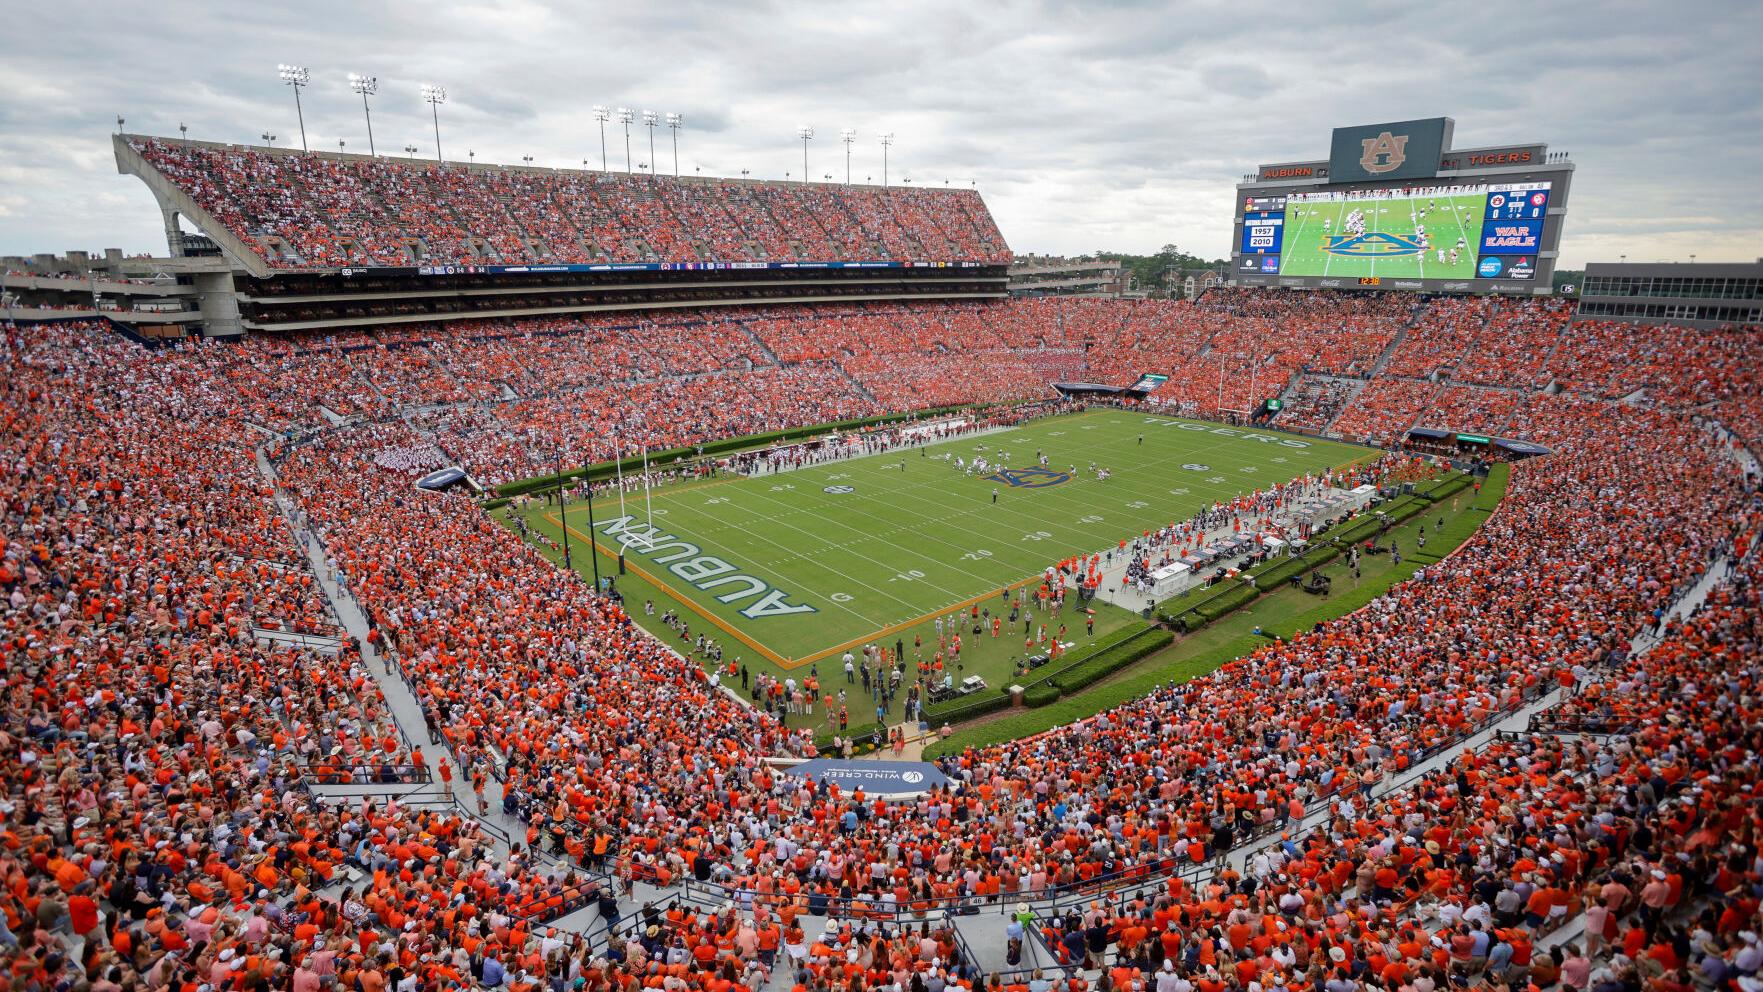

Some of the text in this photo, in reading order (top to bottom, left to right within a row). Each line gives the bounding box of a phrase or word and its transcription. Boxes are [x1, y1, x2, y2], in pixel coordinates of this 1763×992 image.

[1470, 151, 1532, 166] TIGERS
[1263, 167, 1312, 178] AUBURN
[1495, 226, 1530, 237] WAR
[1485, 236, 1536, 247] EAGLE
[1142, 417, 1312, 449] TIGERS
[587, 514, 819, 619] AUBURN
[897, 570, 926, 581] 10
[831, 592, 854, 602] G
[821, 771, 900, 780] WIND CREEK
